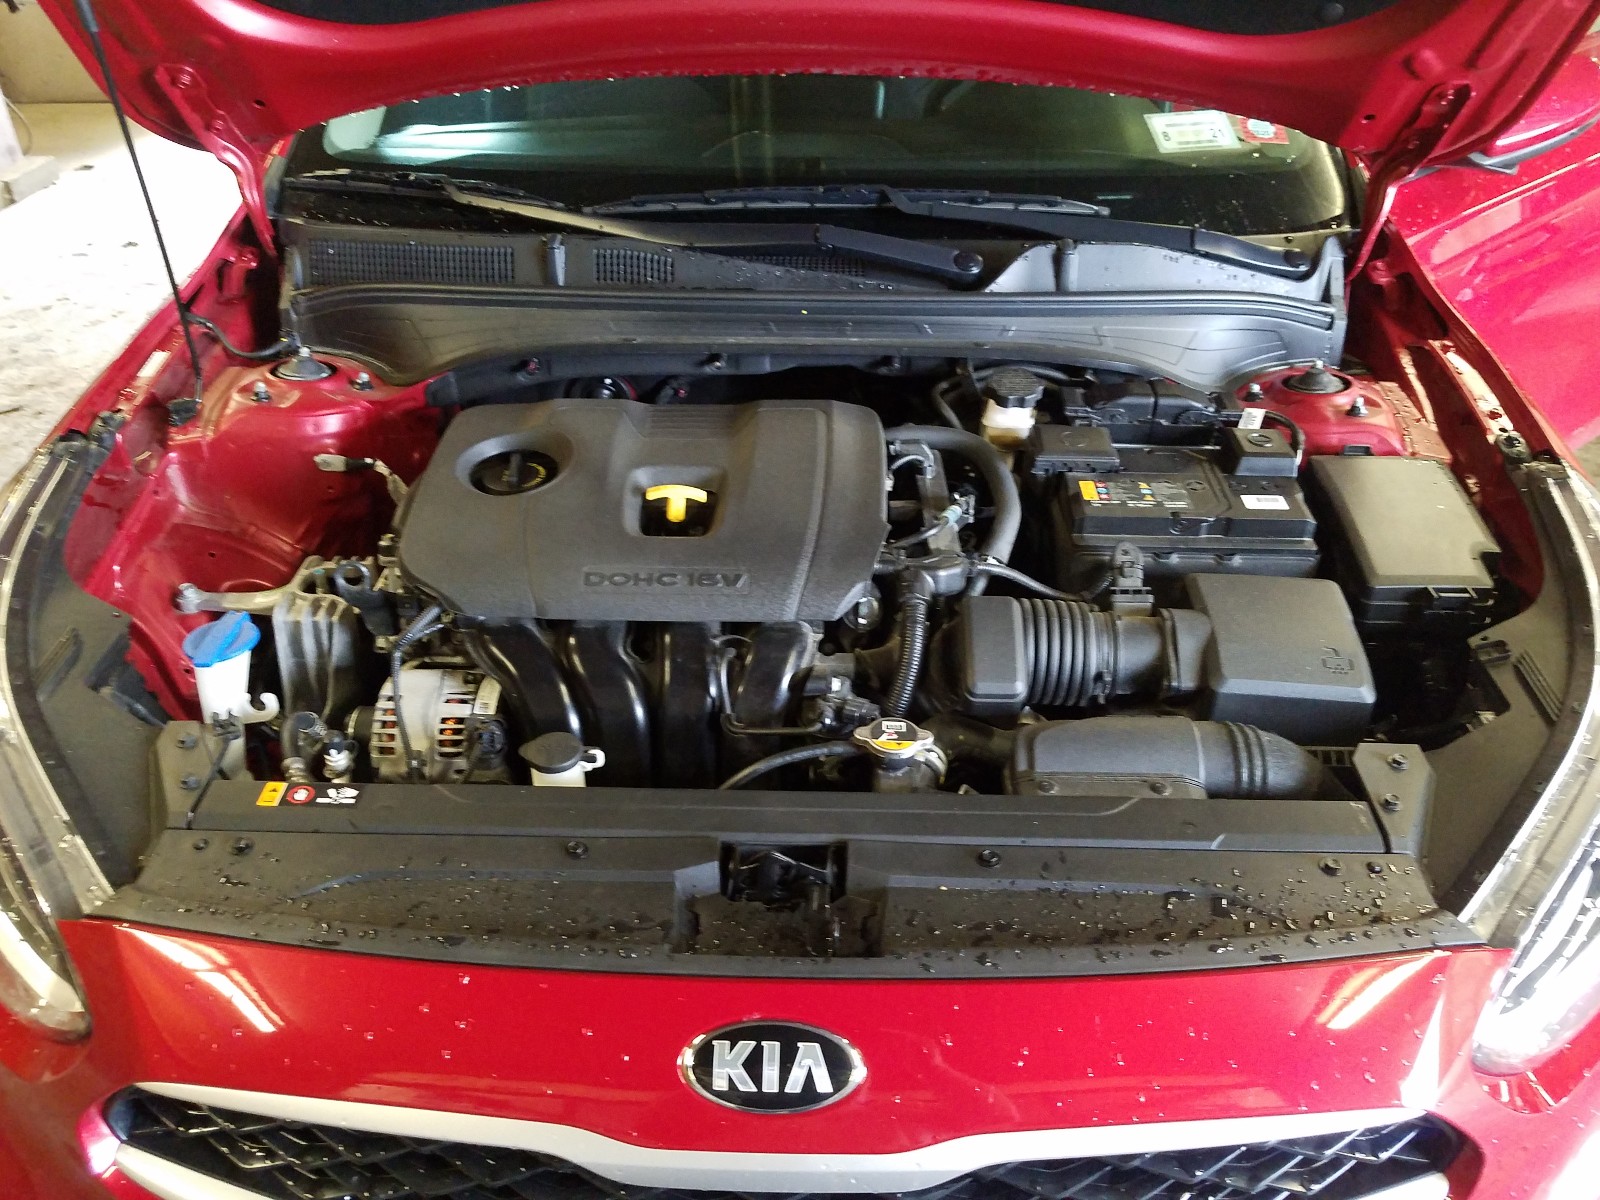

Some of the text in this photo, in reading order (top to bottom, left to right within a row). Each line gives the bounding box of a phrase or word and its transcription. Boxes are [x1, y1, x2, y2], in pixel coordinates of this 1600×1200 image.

[583, 572, 748, 588] DOHC 16V
[712, 1040, 834, 1093] KIA
